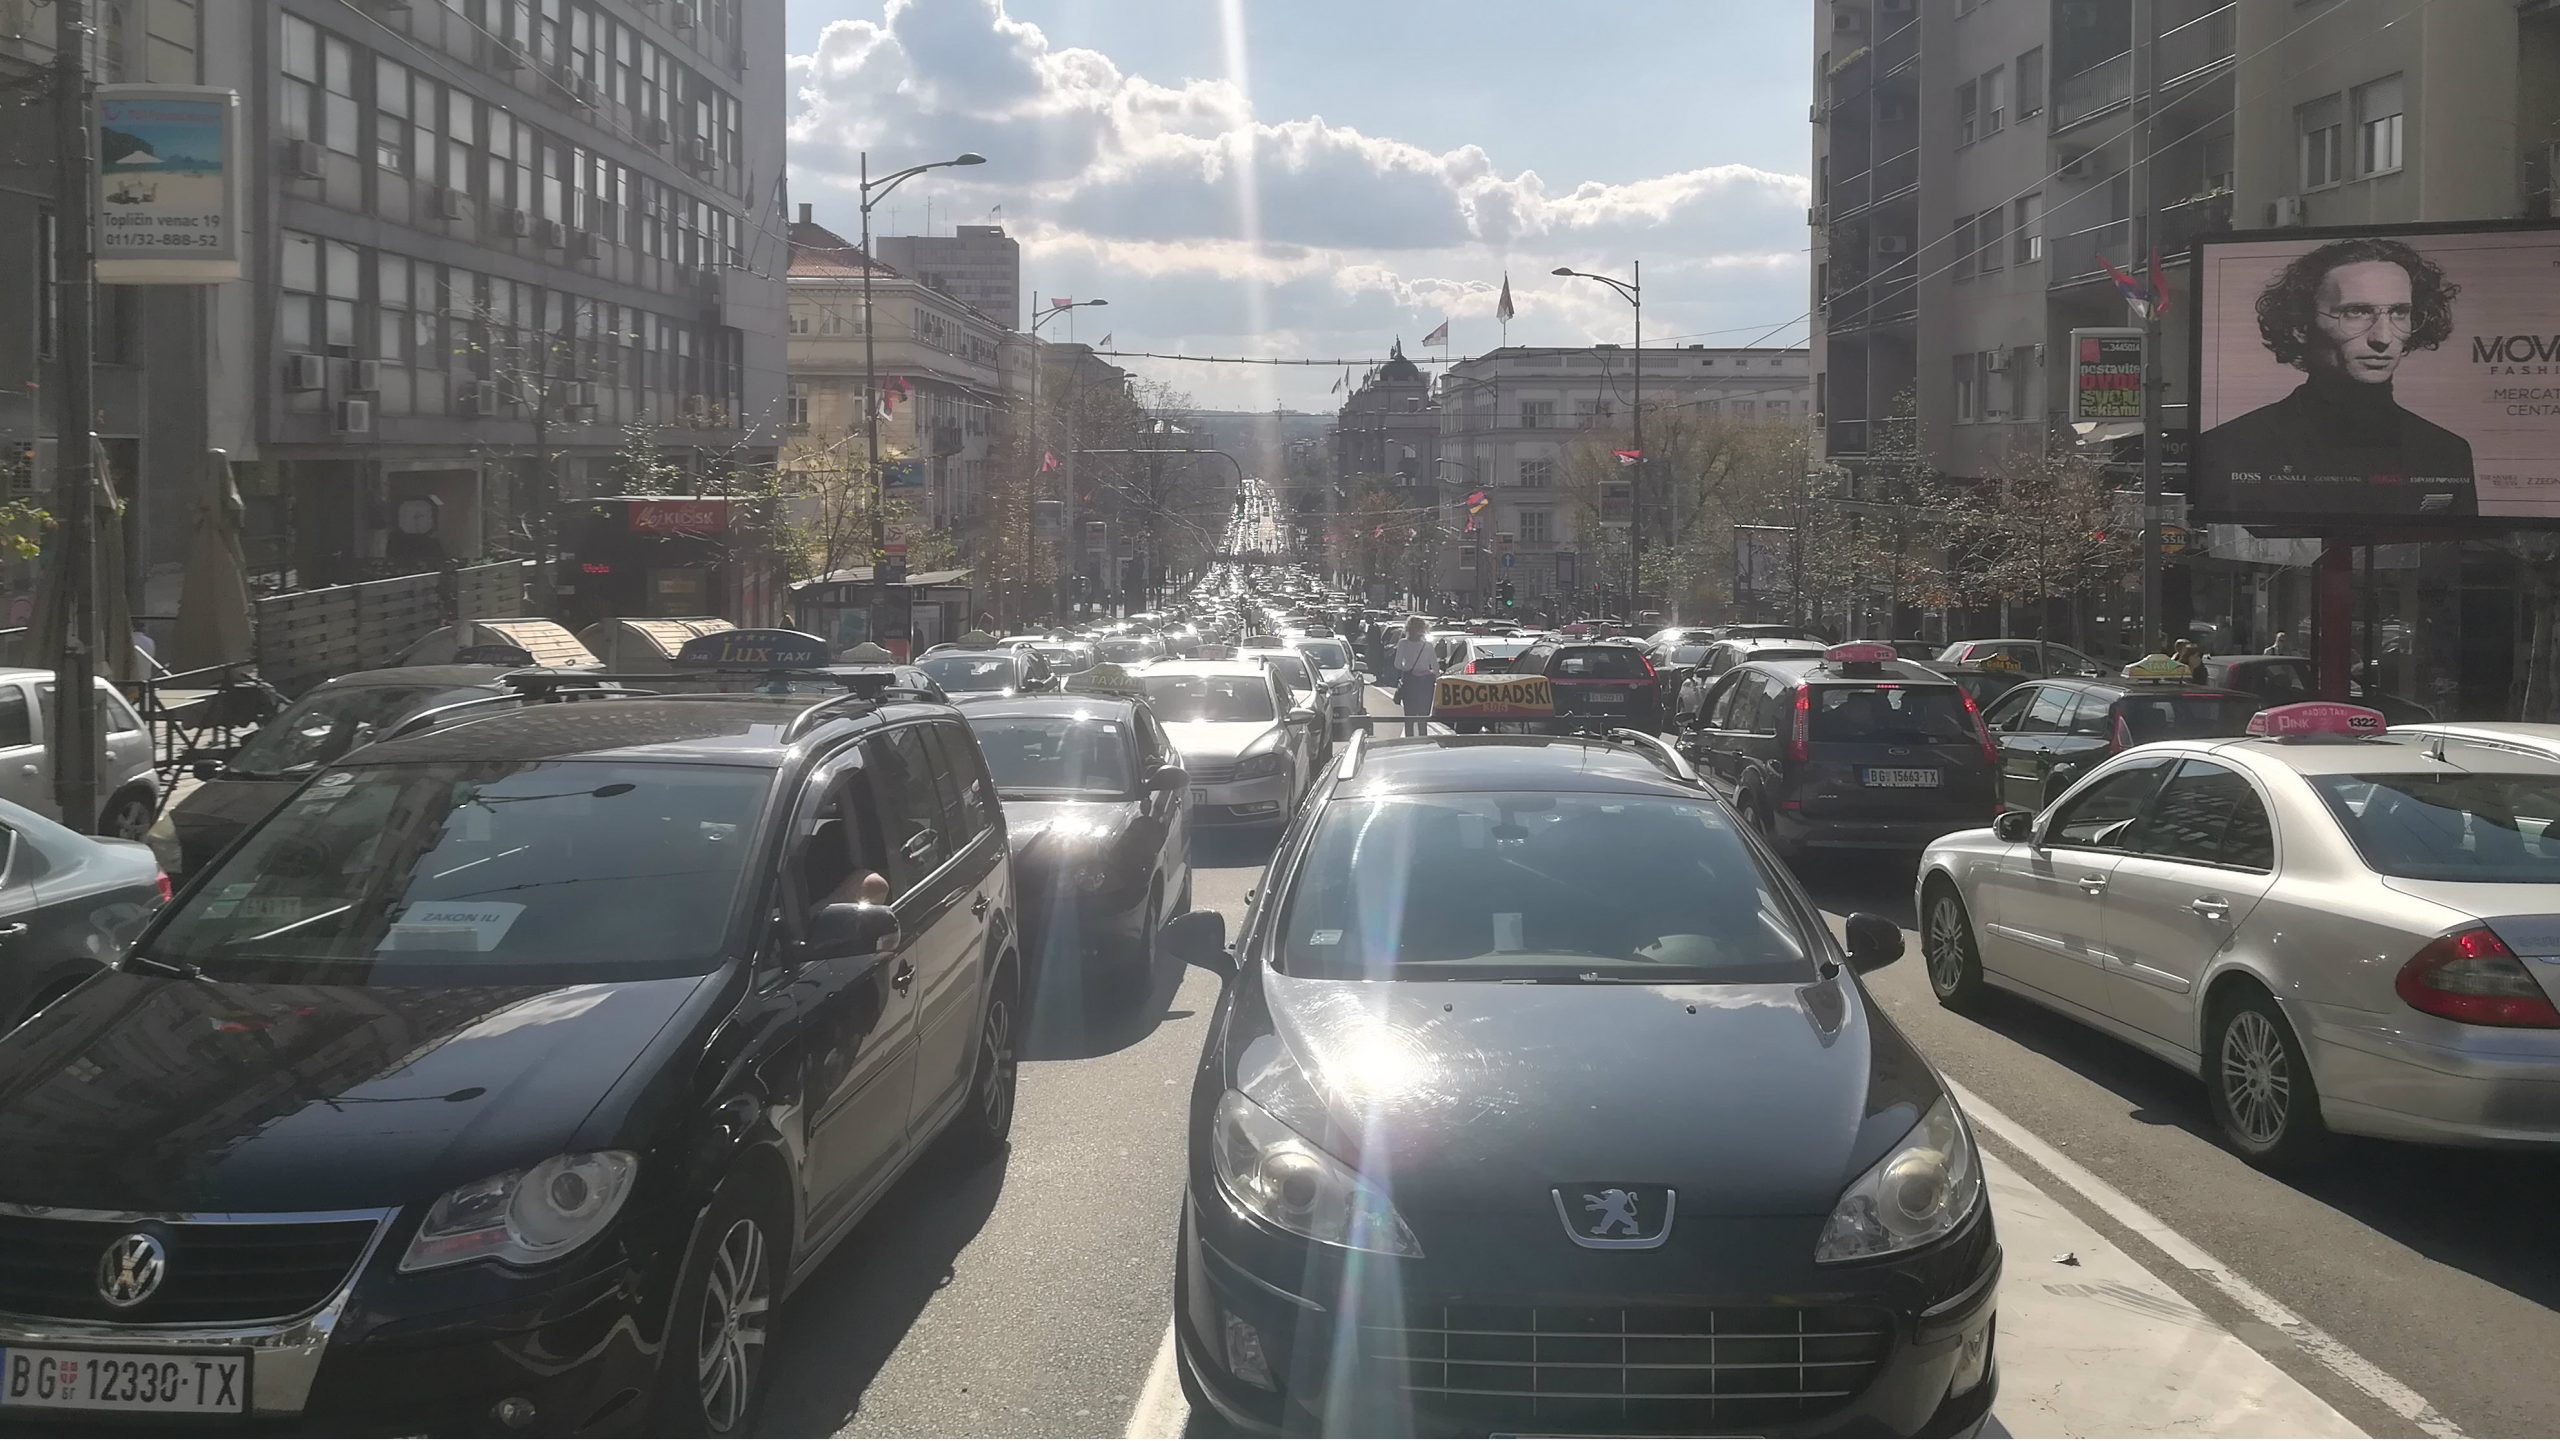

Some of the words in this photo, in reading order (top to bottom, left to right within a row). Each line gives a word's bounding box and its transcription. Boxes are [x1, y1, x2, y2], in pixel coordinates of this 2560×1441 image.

[103, 211, 153, 229] Topličin
[157, 216, 199, 227] venac
[203, 215, 221, 228] 19
[106, 233, 218, 247] 011/32-888-52
[2472, 334, 2560, 364] MOV
[2494, 387, 2560, 400] MERCAT
[2080, 403, 2140, 417] reklamu
[2506, 404, 2560, 416] CENTA
[2231, 472, 2261, 481] BOSS
[2161, 534, 2187, 544] SSIL
[718, 642, 773, 663] Lux
[775, 651, 811, 662] TAXI
[1441, 680, 1551, 706] BEOGRADSKI
[2302, 708, 2327, 717] RADIO
[2348, 717, 2378, 728] 1322
[1871, 770, 1887, 783] BG
[420, 912, 476, 923] ZAKON
[480, 913, 500, 923] ILI
[11, 1354, 57, 1400] BG
